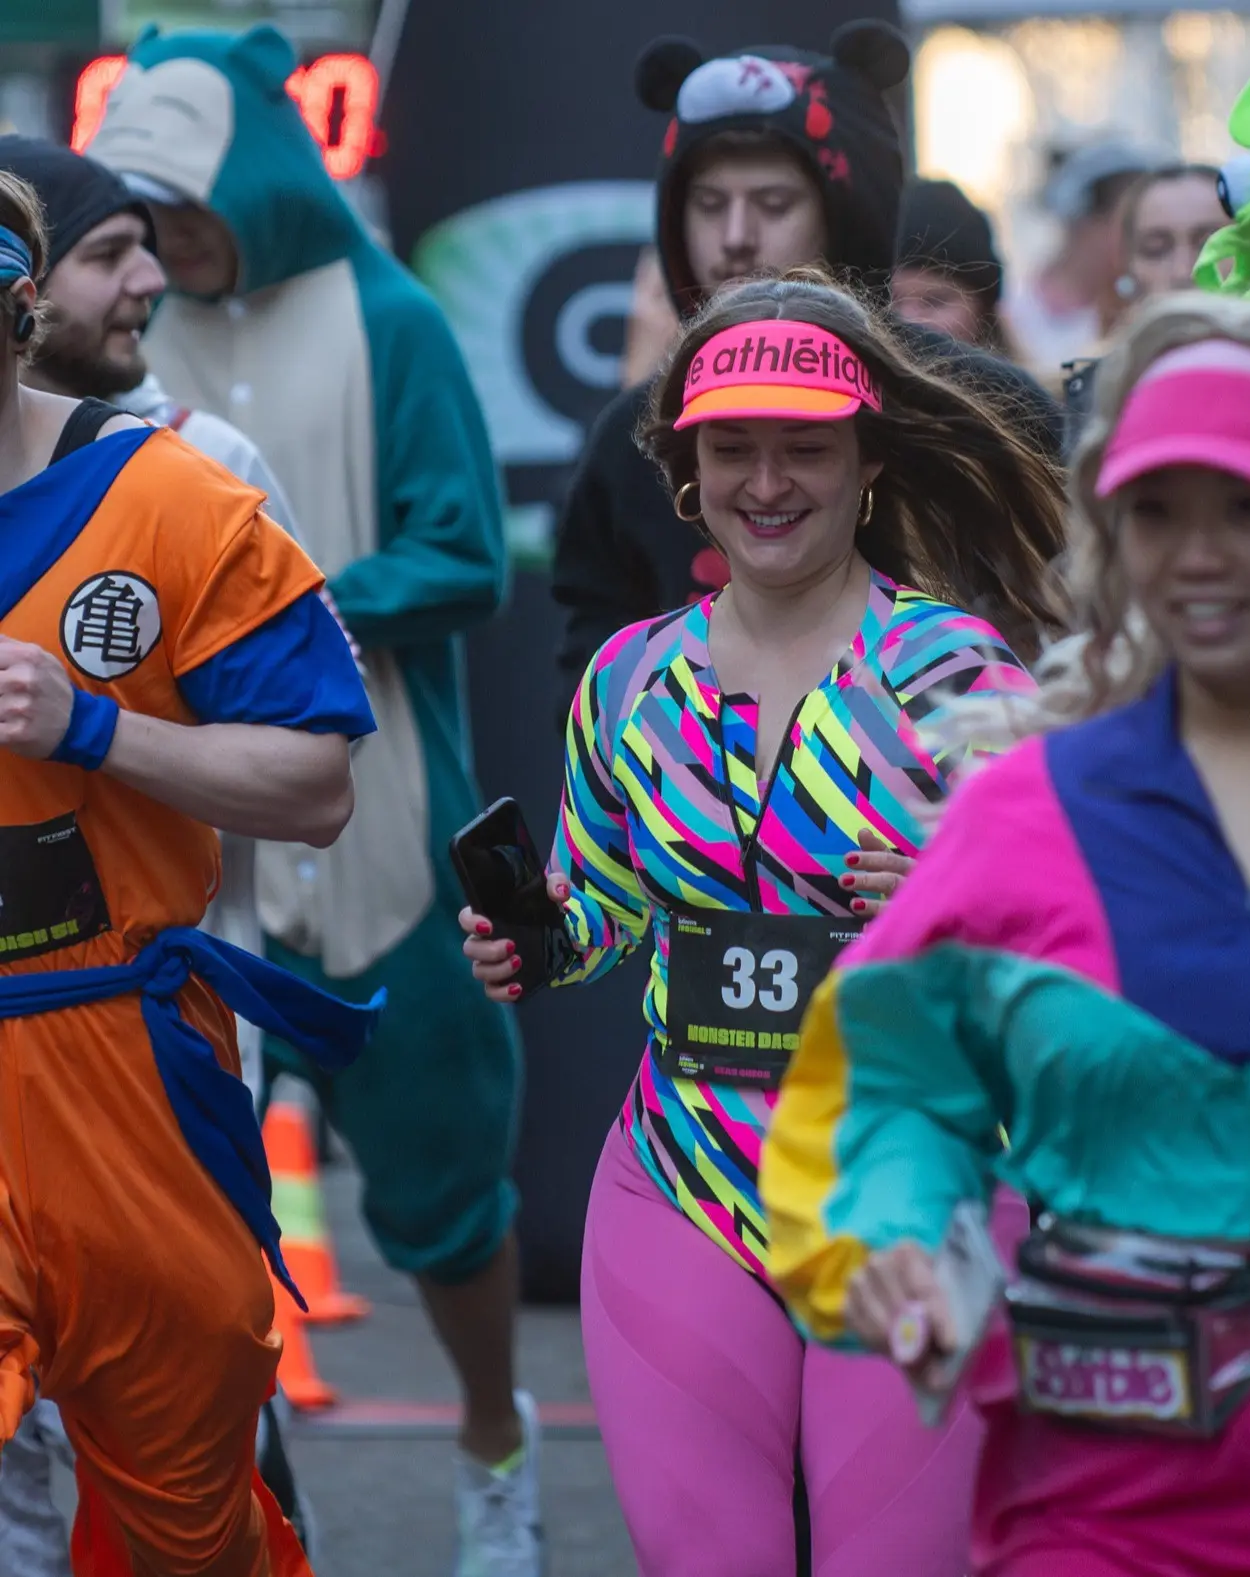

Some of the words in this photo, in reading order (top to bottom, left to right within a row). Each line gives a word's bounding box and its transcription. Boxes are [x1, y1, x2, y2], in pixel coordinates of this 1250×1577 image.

[721, 946, 799, 1012] 33
[687, 1023, 756, 1049] MONSTER
[757, 1031, 800, 1051] DAS
